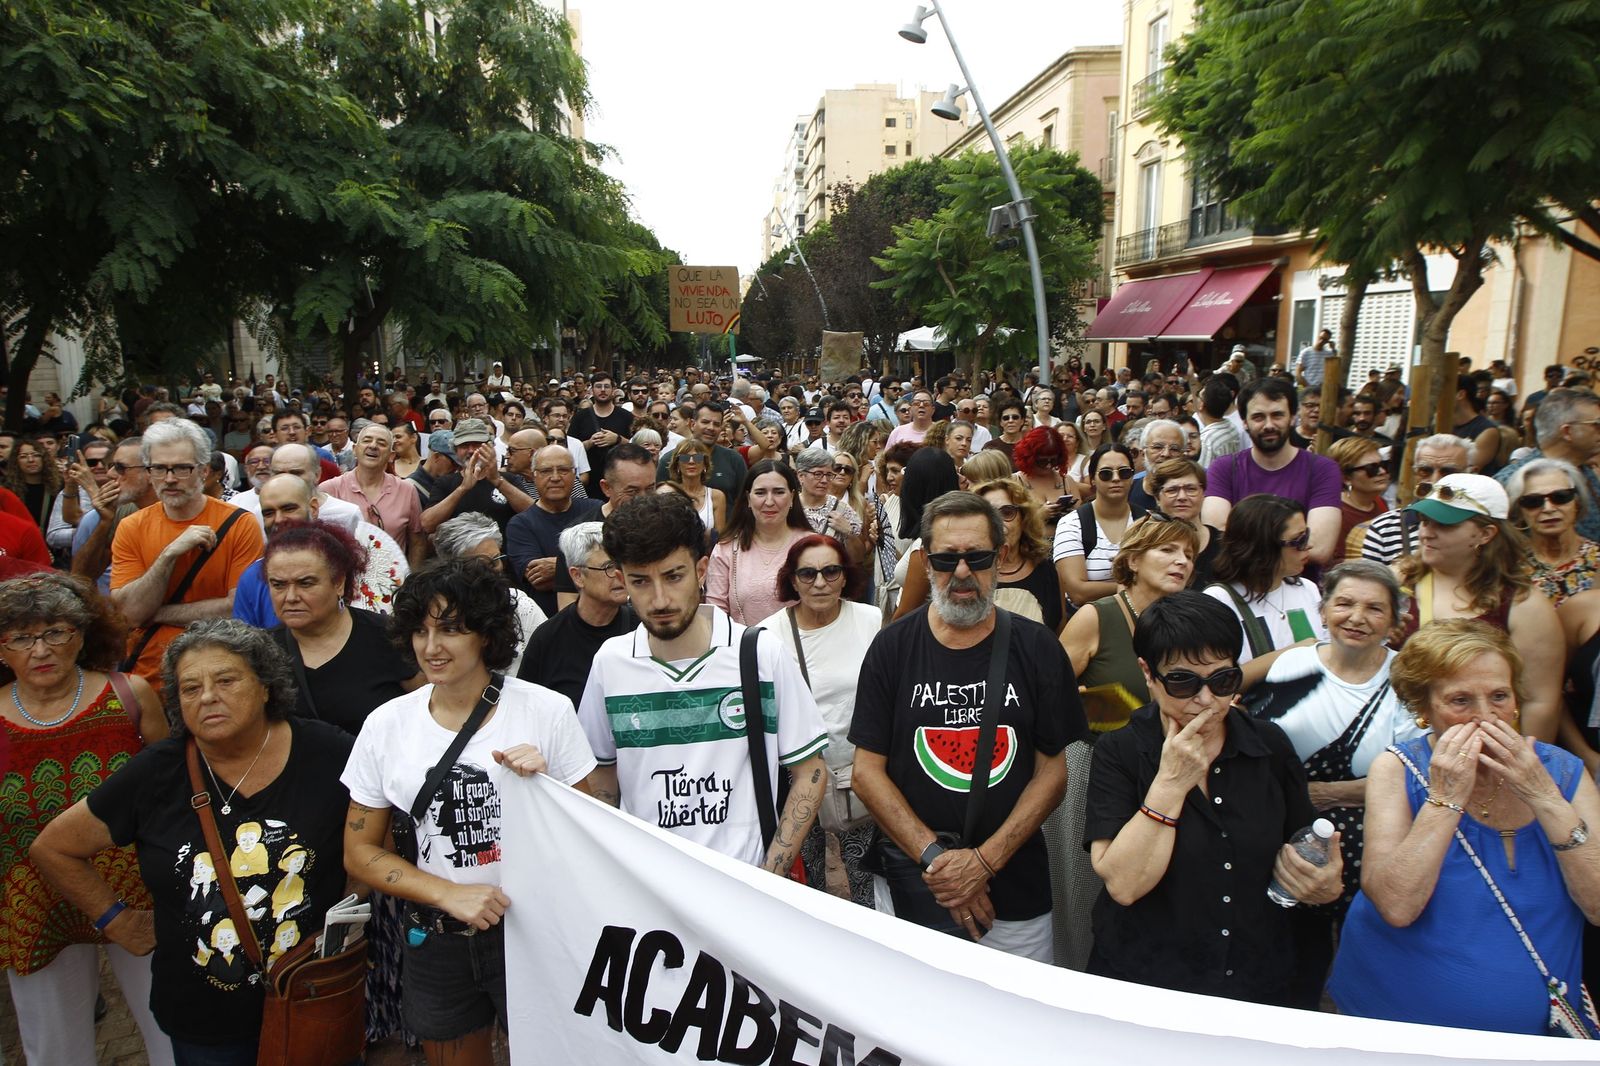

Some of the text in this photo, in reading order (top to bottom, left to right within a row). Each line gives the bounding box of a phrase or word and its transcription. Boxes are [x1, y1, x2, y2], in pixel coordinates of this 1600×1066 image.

[677, 268, 723, 283] QUE LA
[679, 285, 730, 297] VIVIENDA
[674, 297, 738, 310] NO SEA UN
[686, 311, 724, 326] LUJO
[910, 680, 1020, 708] PALESTIA
[944, 707, 983, 724] LIBRE
[453, 779, 498, 805] Ni guapa,
[723, 779, 733, 798] y
[455, 803, 466, 823] ni
[457, 825, 469, 846] ni
